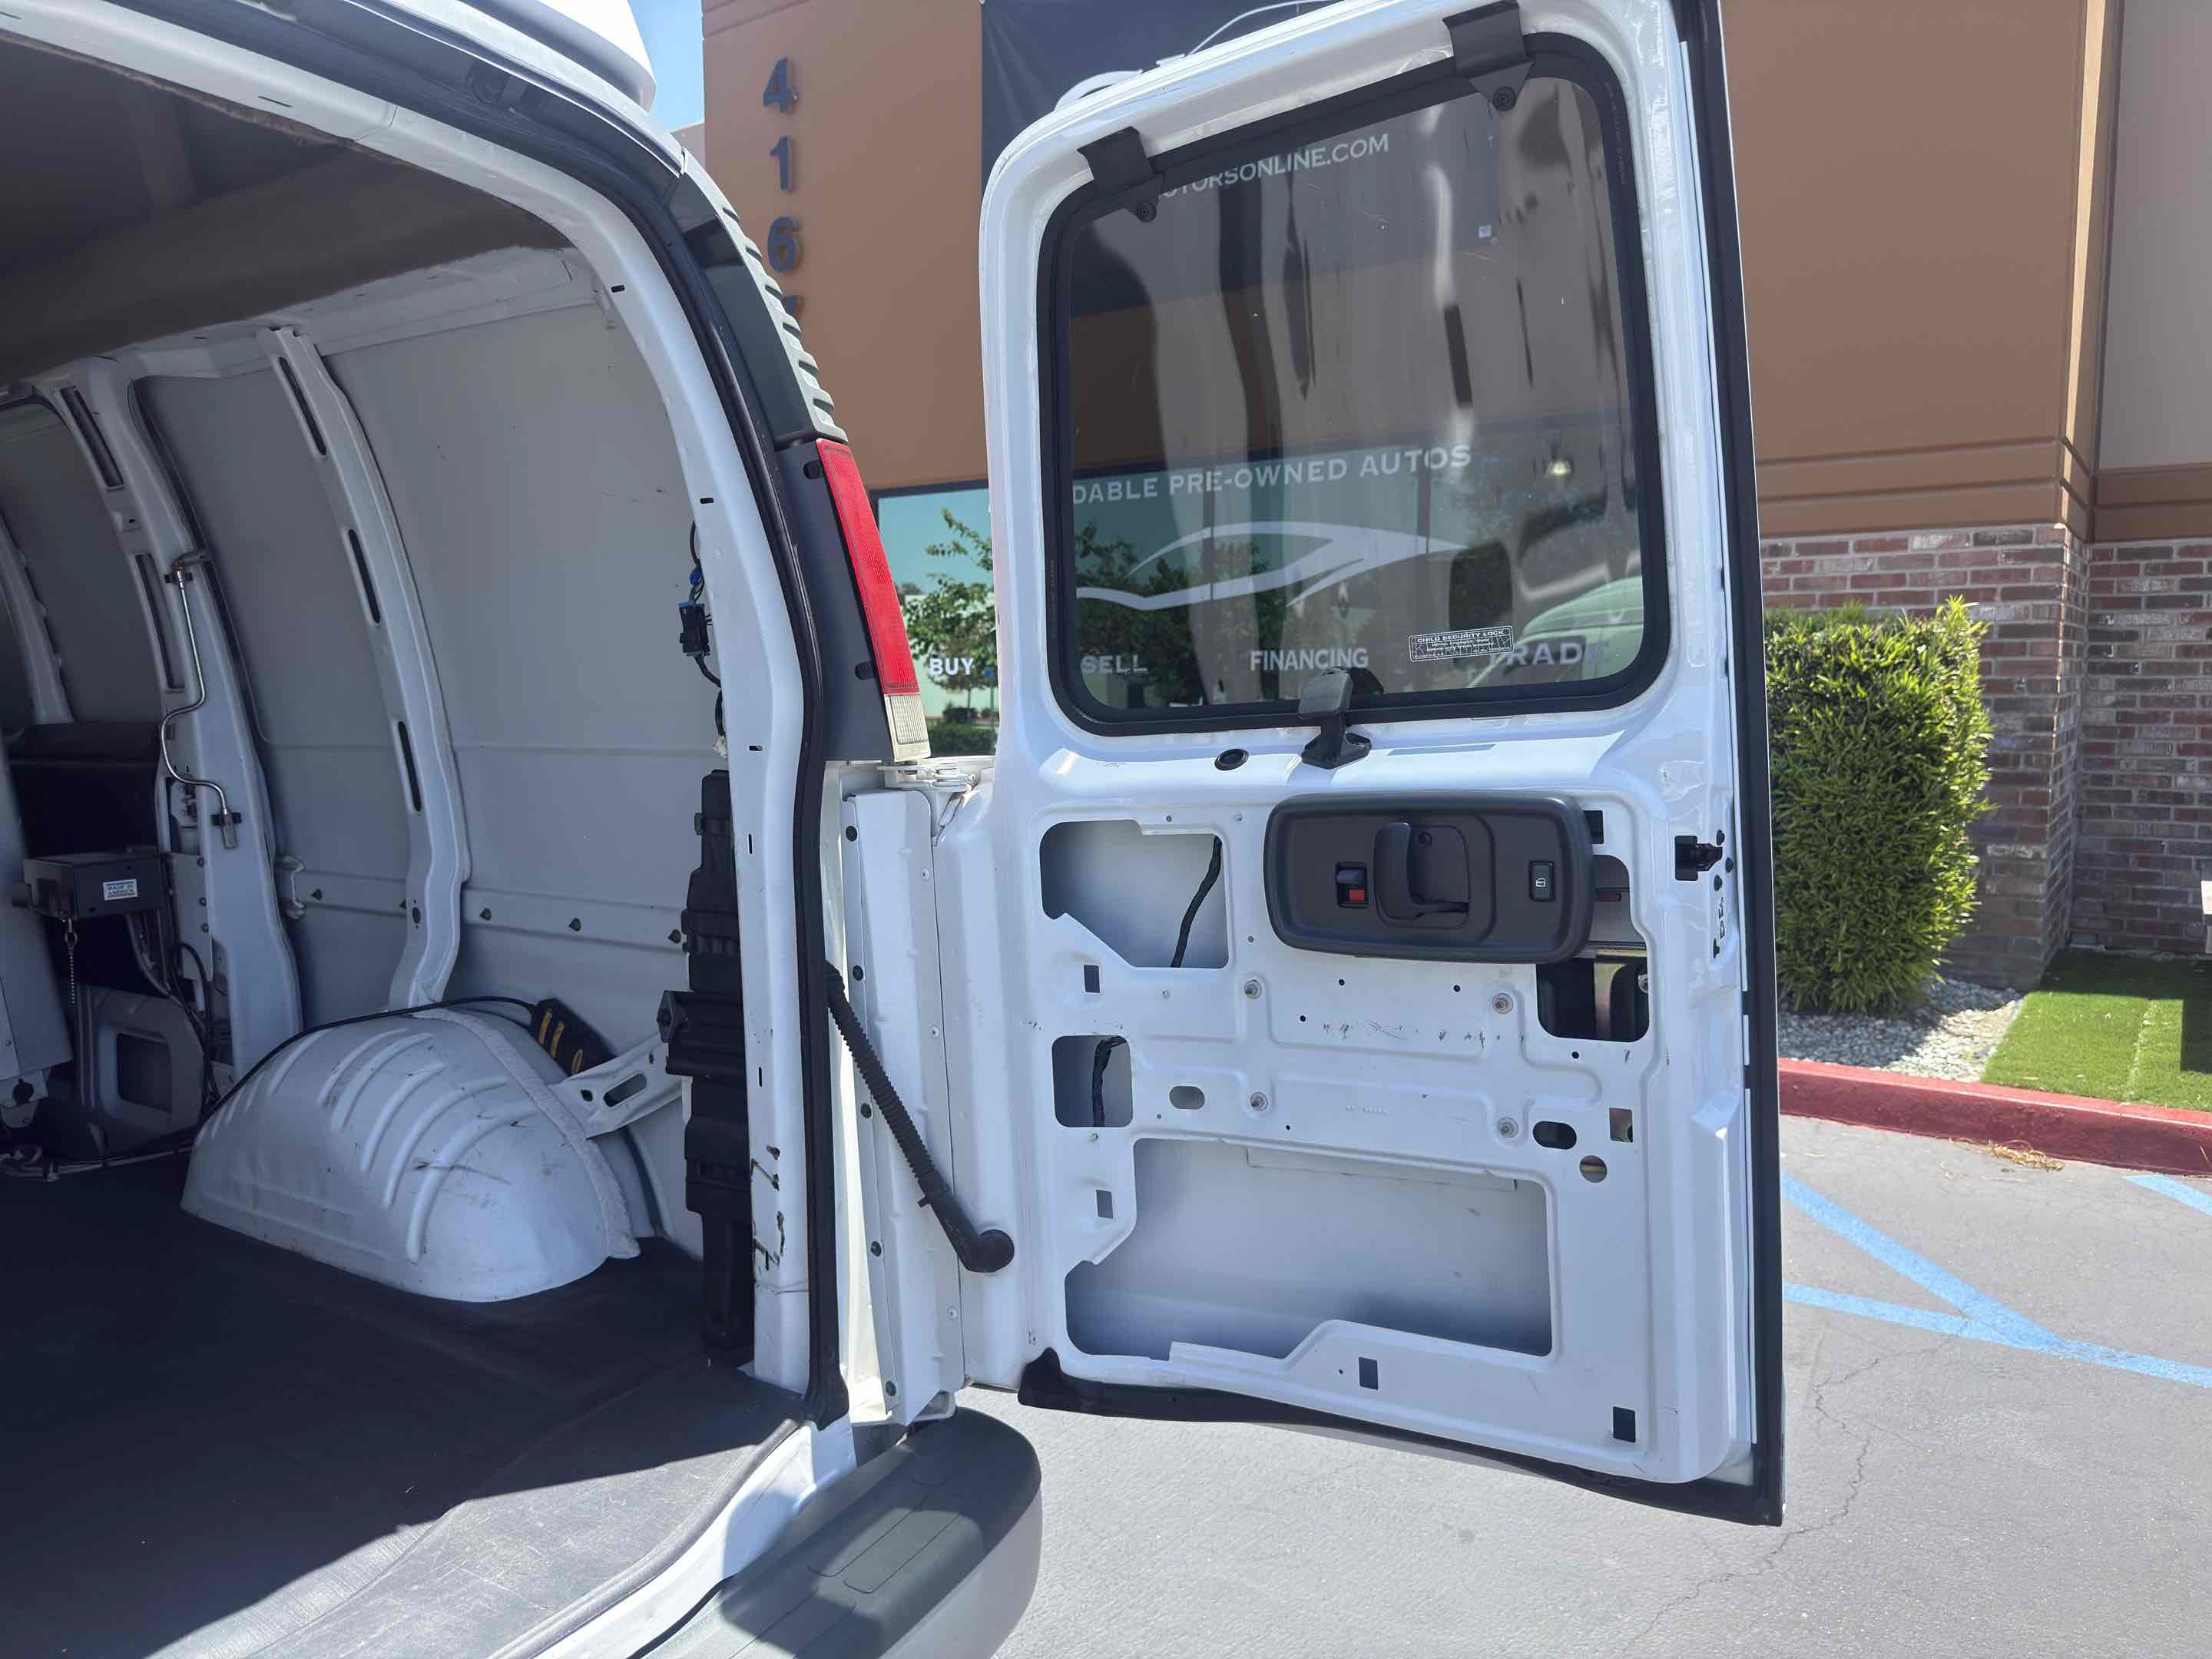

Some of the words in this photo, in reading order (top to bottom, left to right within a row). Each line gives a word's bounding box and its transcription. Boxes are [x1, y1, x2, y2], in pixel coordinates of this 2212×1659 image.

[1072, 477, 1158, 505] DABLE
[1168, 459, 1348, 495] PRE-OWNED
[1359, 444, 1472, 478] AUTOS
[929, 658, 975, 676] BUY
[1081, 654, 1147, 674] SELL
[1250, 647, 1369, 671] FINANCING
